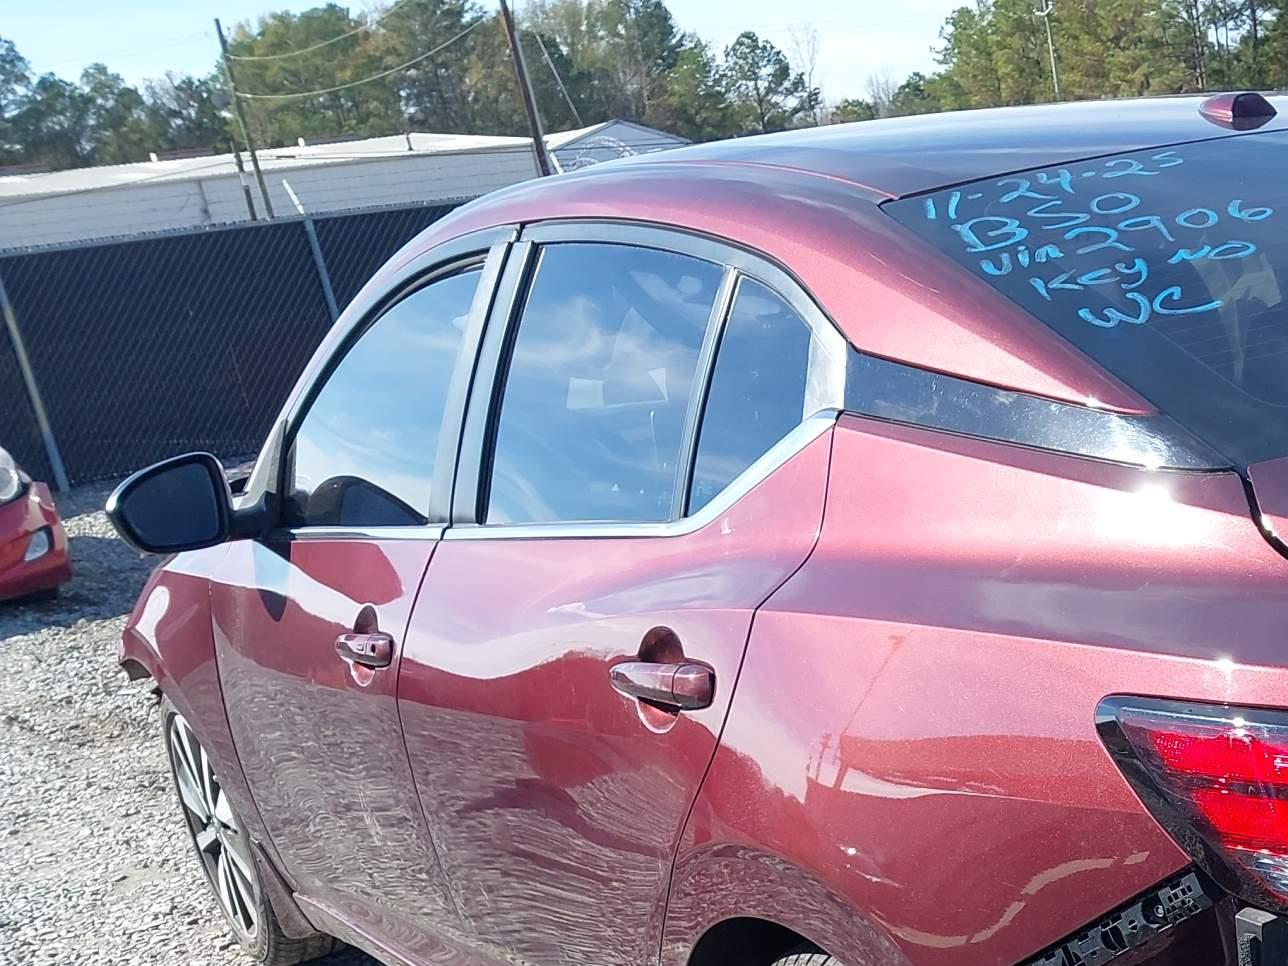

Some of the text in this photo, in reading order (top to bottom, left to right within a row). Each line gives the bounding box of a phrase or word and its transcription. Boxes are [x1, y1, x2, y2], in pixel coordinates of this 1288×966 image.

[925, 151, 1184, 220] 11-24-25
[1064, 199, 1274, 255] 2906
[1078, 286, 1224, 329] WC
